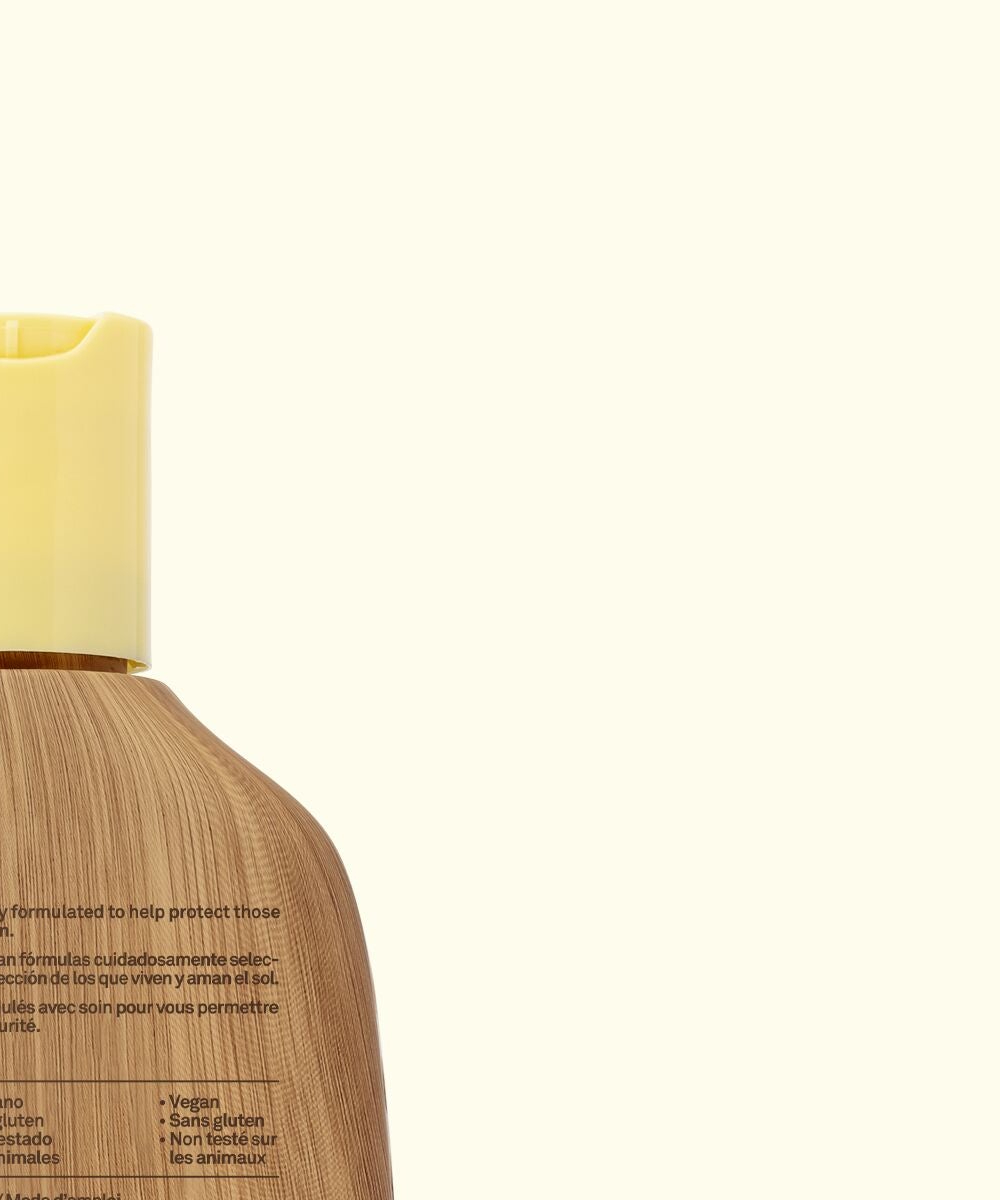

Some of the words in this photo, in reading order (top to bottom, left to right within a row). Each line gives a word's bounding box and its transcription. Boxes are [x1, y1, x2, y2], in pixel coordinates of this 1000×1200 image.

[11, 904, 104, 919] formulated
[108, 904, 125, 919] to
[129, 904, 165, 923] help
[169, 904, 230, 923] protect
[233, 904, 280, 919] those
[19, 951, 90, 966] fórmulas
[94, 951, 227, 966] cuidadosamente
[229, 951, 279, 966] selec-
[50, 970, 70, 985] de
[73, 970, 95, 985] los
[99, 973, 128, 989] que
[131, 970, 172, 985] viven
[174, 973, 183, 989] y
[186, 973, 232, 985] aman
[235, 970, 248, 985] el
[251, 970, 279, 985] sol.
[38, 1002, 76, 1014] avec
[78, 999, 112, 1014] soin
[116, 1002, 154, 1018] pour
[156, 1002, 194, 1014] vous
[197, 999, 279, 1018] permettre
[169, 1093, 220, 1112] Vegan
[169, 1112, 209, 1127] Sans
[213, 1112, 265, 1131] gluten
[169, 1130, 202, 1146] Non
[205, 1130, 248, 1146] testé
[251, 1134, 277, 1146] sur
[169, 1149, 193, 1164] les
[196, 1149, 266, 1164] animaux
